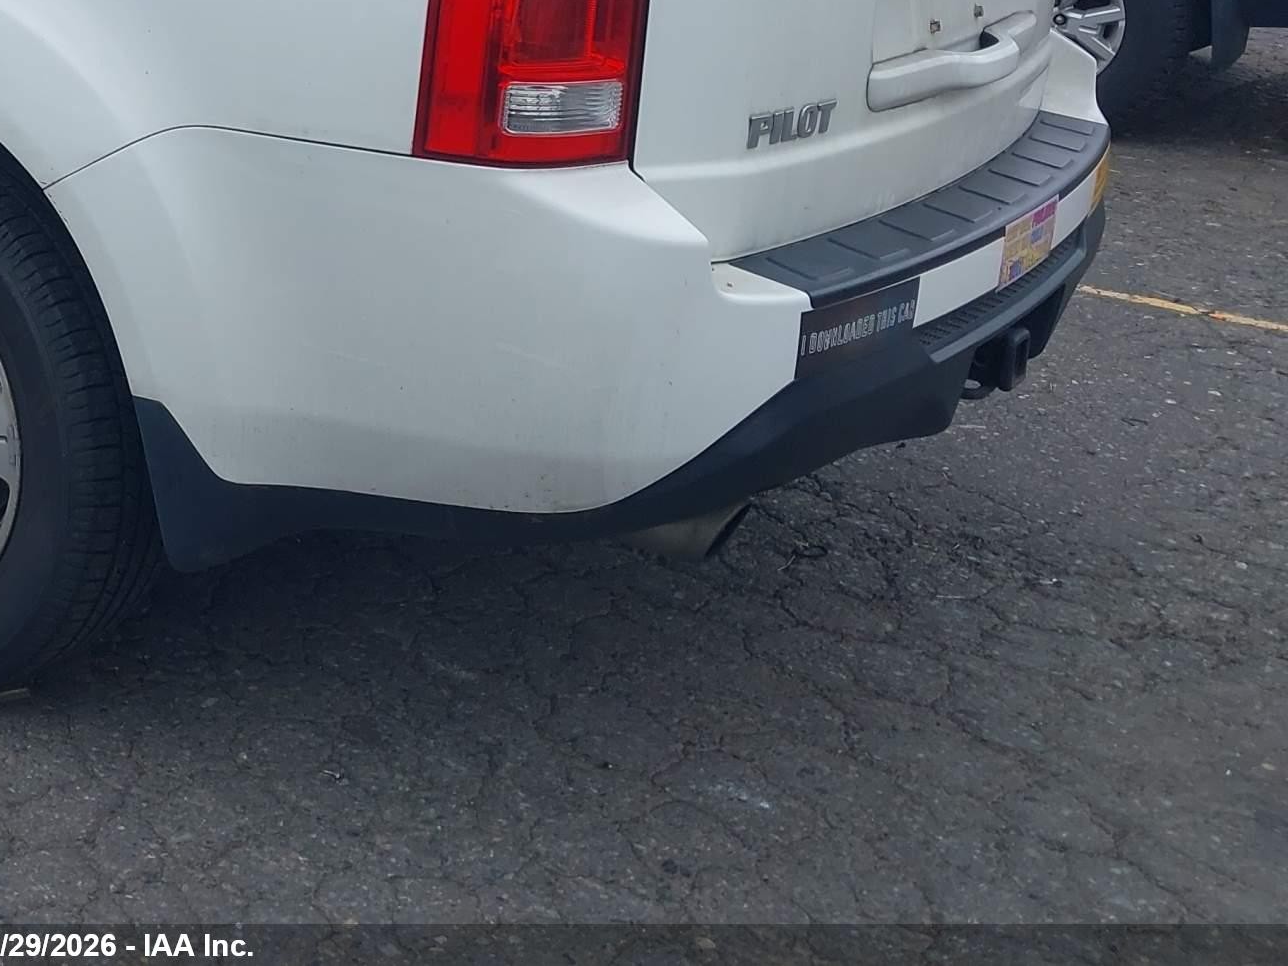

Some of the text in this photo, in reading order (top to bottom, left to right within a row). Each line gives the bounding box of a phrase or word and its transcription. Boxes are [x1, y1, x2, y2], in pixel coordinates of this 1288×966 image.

[746, 98, 838, 149] PILOT
[800, 334, 807, 356] I
[808, 314, 876, 354] DOWNLOADED
[876, 306, 897, 332] THIS
